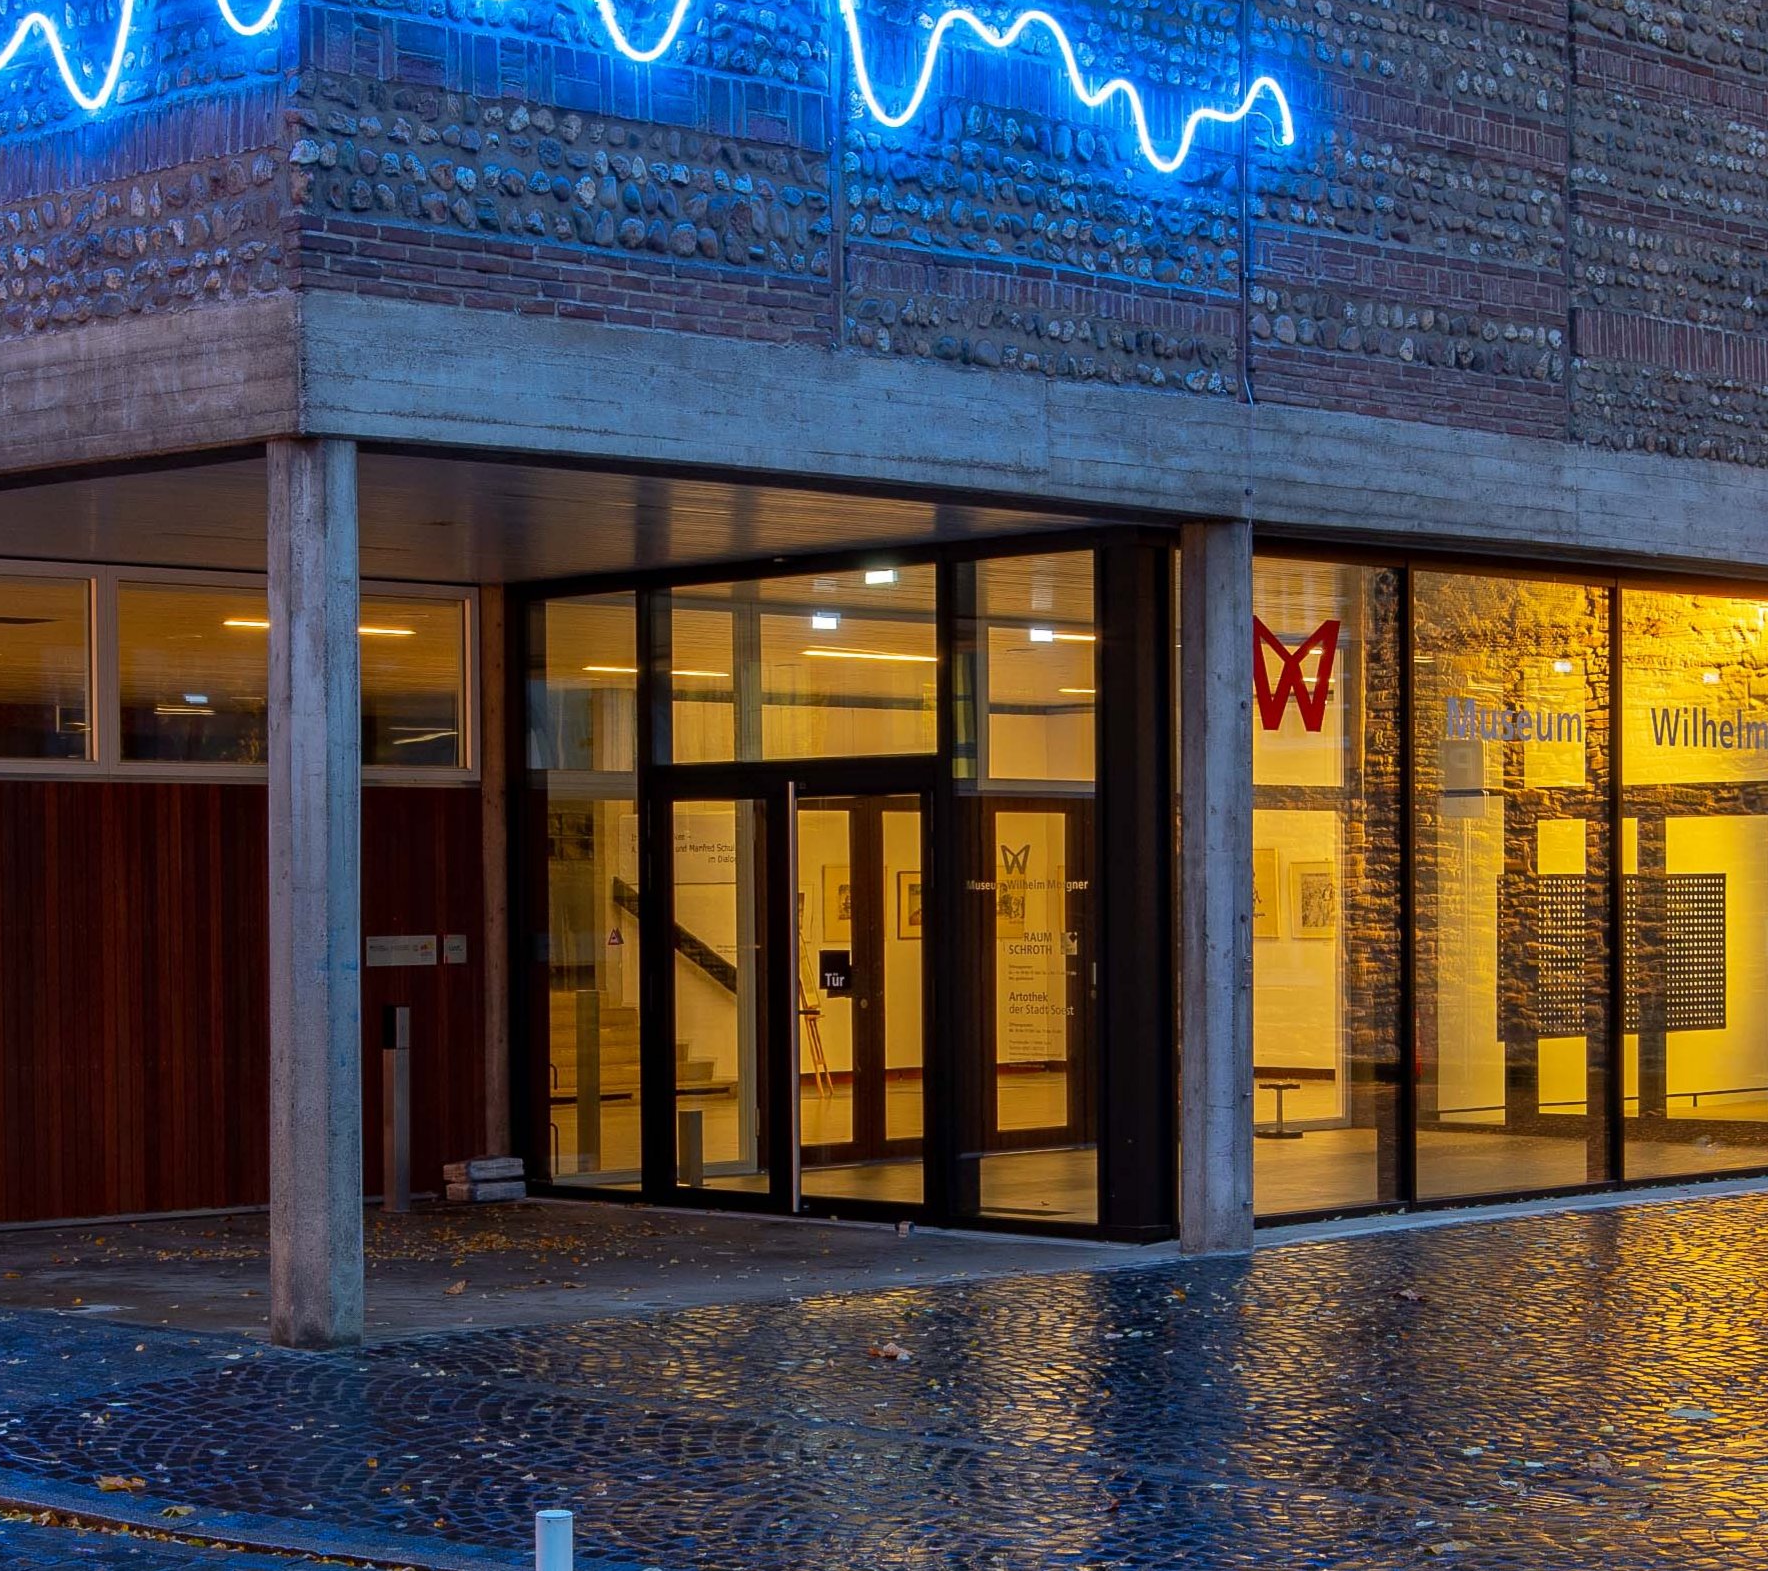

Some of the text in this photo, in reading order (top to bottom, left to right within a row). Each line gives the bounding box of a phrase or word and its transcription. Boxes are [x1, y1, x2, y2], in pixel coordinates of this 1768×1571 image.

[1446, 697, 1581, 743] Museum
[1651, 707, 1768, 750] Wilhelm
[1023, 932, 1052, 942] RAUM
[1009, 945, 1052, 955] SCHROTH
[824, 973, 845, 987] Tür
[1009, 992, 1048, 1002] Artothek
[1010, 1005, 1074, 1015] der Stadt Soest
